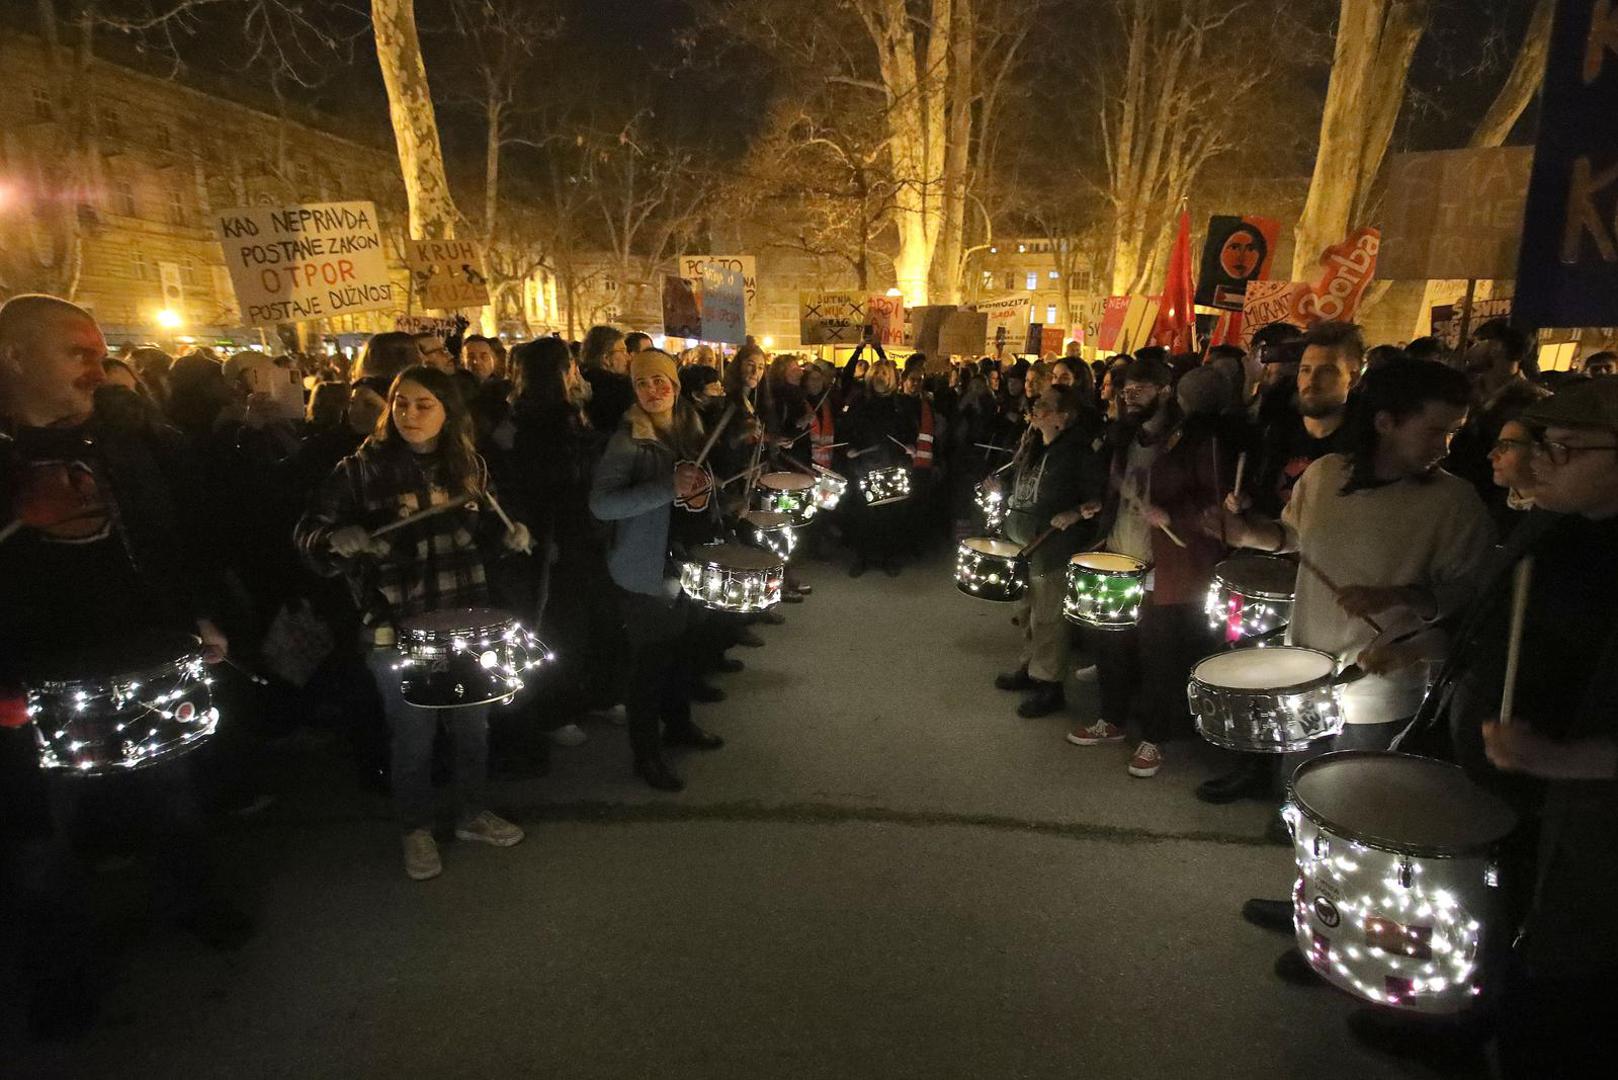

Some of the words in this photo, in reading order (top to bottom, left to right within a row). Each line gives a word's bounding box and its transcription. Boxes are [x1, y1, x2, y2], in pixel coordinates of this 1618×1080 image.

[221, 217, 259, 238] KAD
[271, 207, 371, 233] NEPRAVDA
[240, 236, 325, 267] POSTANE
[327, 233, 379, 254] ZAKON
[416, 242, 475, 262] KRUH
[686, 256, 743, 275] POTO
[261, 259, 356, 294] OTPOR
[249, 296, 322, 324] POSTAJE
[329, 284, 392, 310] DUŽNOST
[1244, 291, 1292, 326] MIGRANT
